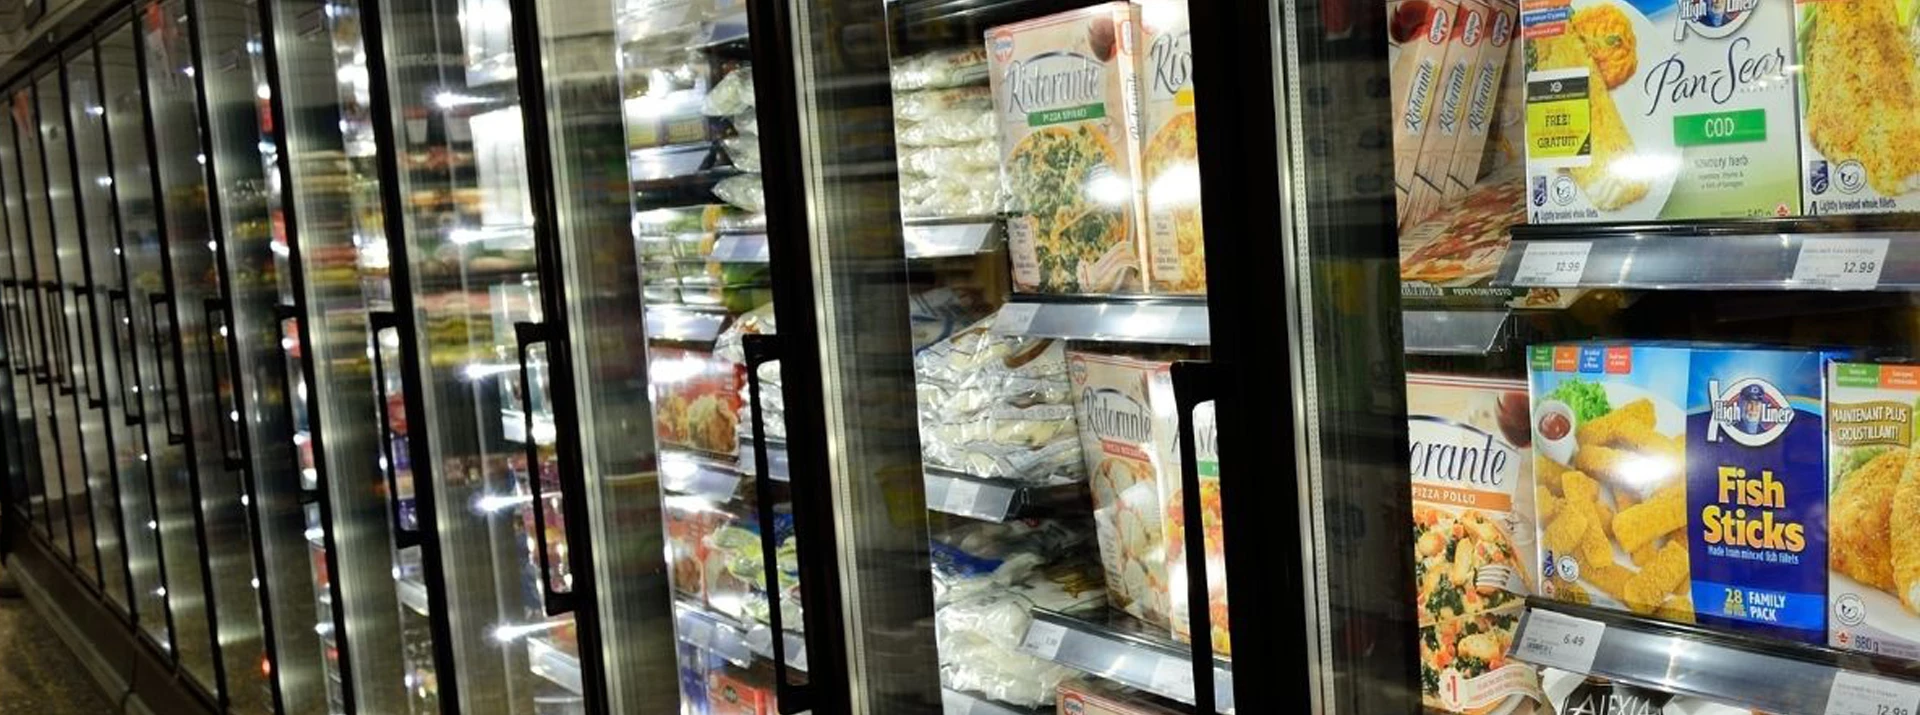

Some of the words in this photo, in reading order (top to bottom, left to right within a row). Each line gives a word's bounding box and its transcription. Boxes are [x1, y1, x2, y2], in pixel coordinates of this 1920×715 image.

[1004, 56, 1099, 114] Ristorante
[1644, 37, 1787, 116] Pan-Sear
[1545, 114, 1571, 127] FREE!
[1705, 116, 1735, 138] COD
[1556, 262, 1581, 271] 12.99
[1843, 262, 1876, 274] 12.99
[1714, 401, 1741, 425] High
[1761, 403, 1791, 423] Liner
[1832, 407, 1883, 423] MAINTENANT
[1885, 406, 1907, 423] PLUS
[1838, 425, 1899, 441] CROUSTILLANT!
[1718, 466, 1786, 508] Fish
[1443, 490, 1476, 504] POLLO
[1702, 504, 1806, 553] Sticks
[1725, 588, 1743, 604] 28
[1749, 591, 1786, 609] FAMILY
[1750, 606, 1777, 622] PACK
